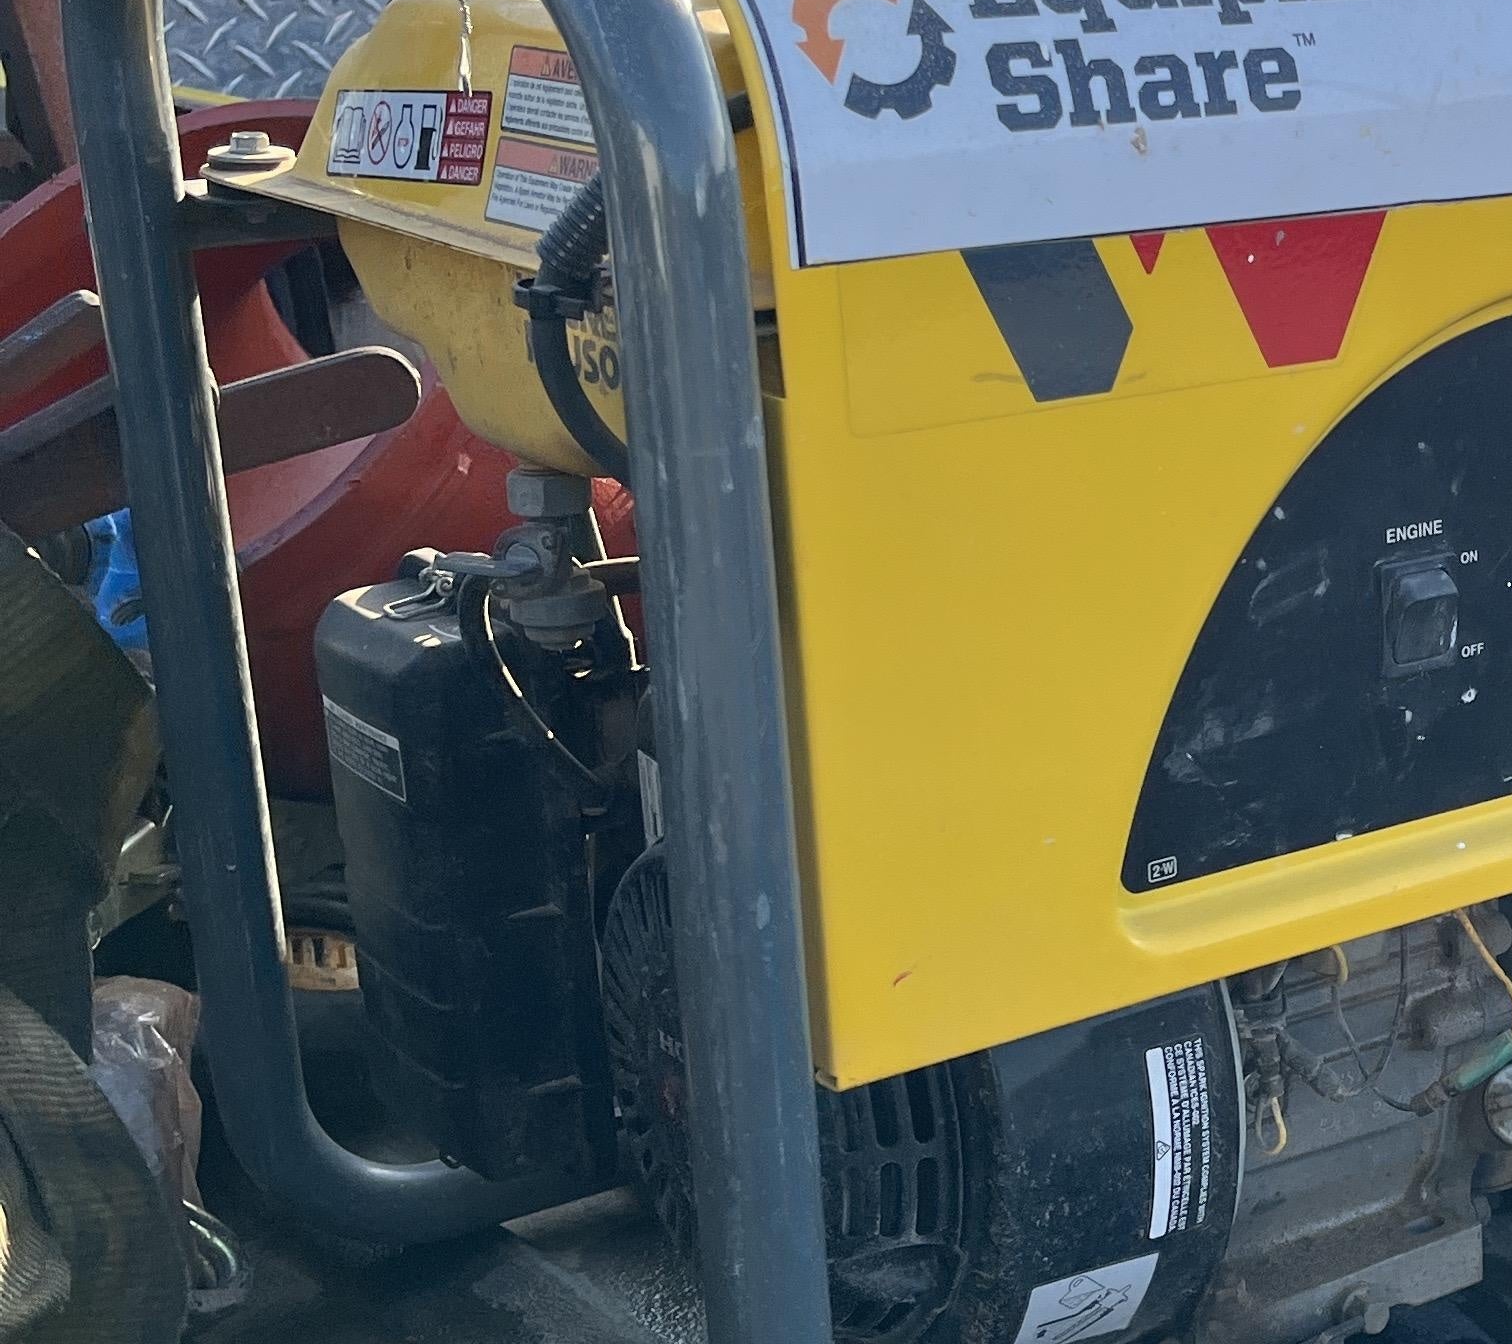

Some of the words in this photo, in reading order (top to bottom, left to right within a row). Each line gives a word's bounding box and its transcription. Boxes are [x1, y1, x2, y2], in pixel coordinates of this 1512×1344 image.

[984, 37, 1302, 133] Share
[456, 97, 488, 114] DANGER
[454, 121, 486, 136] GEFAHR
[450, 143, 484, 159] PELIGRO
[448, 164, 480, 181] DANGER
[1385, 519, 1444, 544] ENGINE
[1460, 550, 1479, 565] ON
[1461, 642, 1485, 658] OFF
